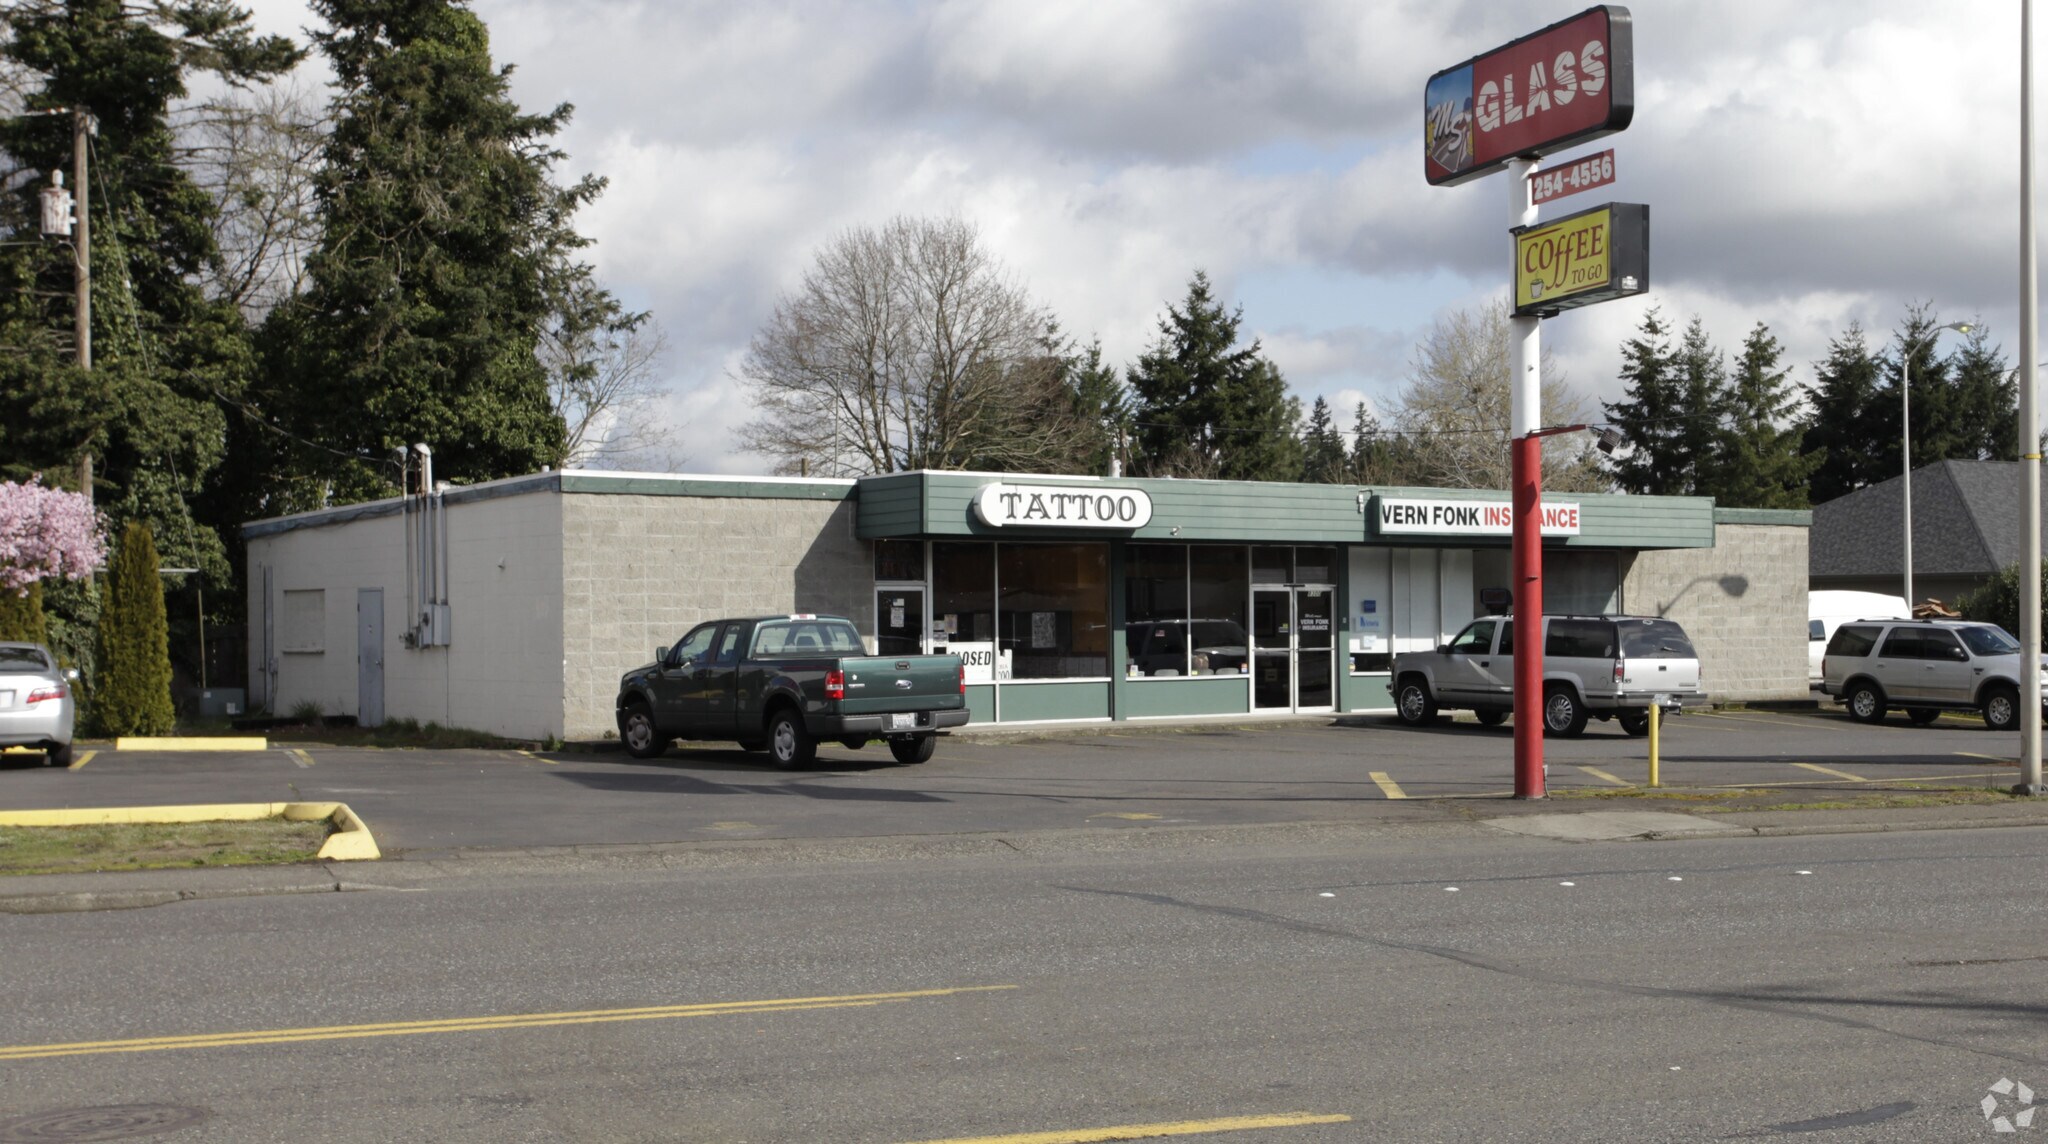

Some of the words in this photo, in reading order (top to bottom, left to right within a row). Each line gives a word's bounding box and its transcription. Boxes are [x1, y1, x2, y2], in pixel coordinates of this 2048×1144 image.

[1476, 40, 1606, 132] GLASS
[1534, 156, 1612, 200] 254-4556
[1572, 268, 1585, 284] TO
[1587, 264, 1602, 281] GO
[1000, 492, 1136, 522] TATTOO
[1382, 505, 1427, 525] VERN
[1433, 506, 1480, 526] FONK
